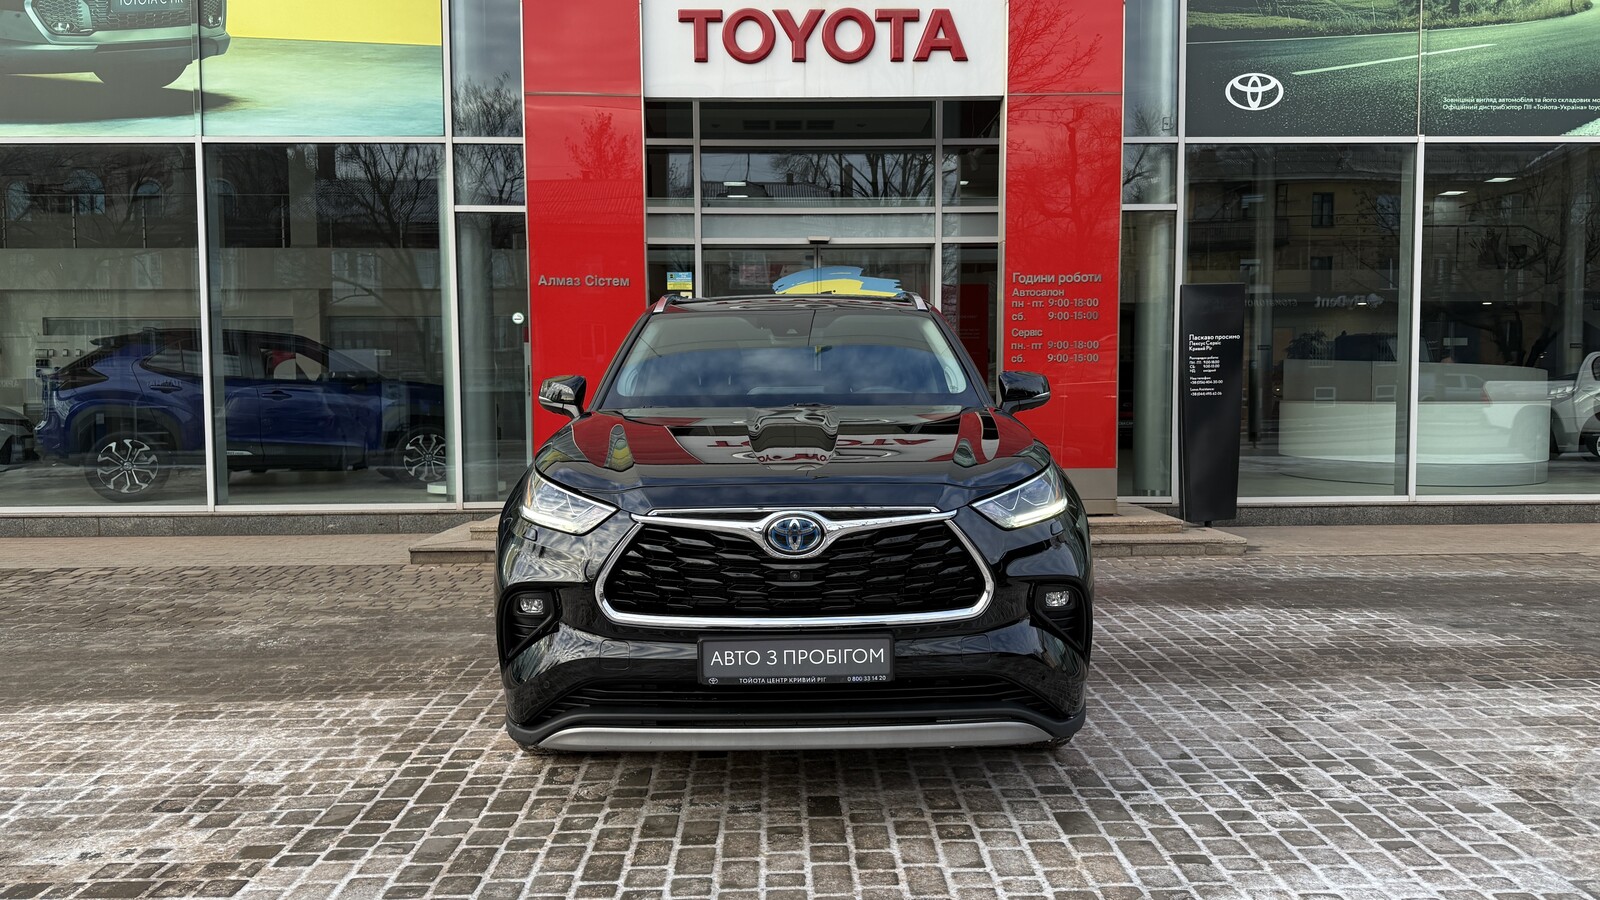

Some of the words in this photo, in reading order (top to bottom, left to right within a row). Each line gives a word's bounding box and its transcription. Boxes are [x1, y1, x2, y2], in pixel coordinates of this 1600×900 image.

[678, 7, 968, 64] TOYOTA
[538, 274, 581, 286] Алмаз
[585, 274, 630, 286] Сістем
[1012, 272, 1055, 285] Години
[1058, 271, 1102, 285] роботи
[1012, 288, 1065, 297] Автосалон
[1011, 312, 1026, 321] сб.
[1011, 328, 1043, 338] Сервіс
[1011, 354, 1026, 363] сб.
[710, 650, 761, 666] АВТО
[766, 650, 778, 666] З
[783, 648, 885, 665] ПРОБІГОМ
[788, 676, 816, 684] КРИВИЙ
